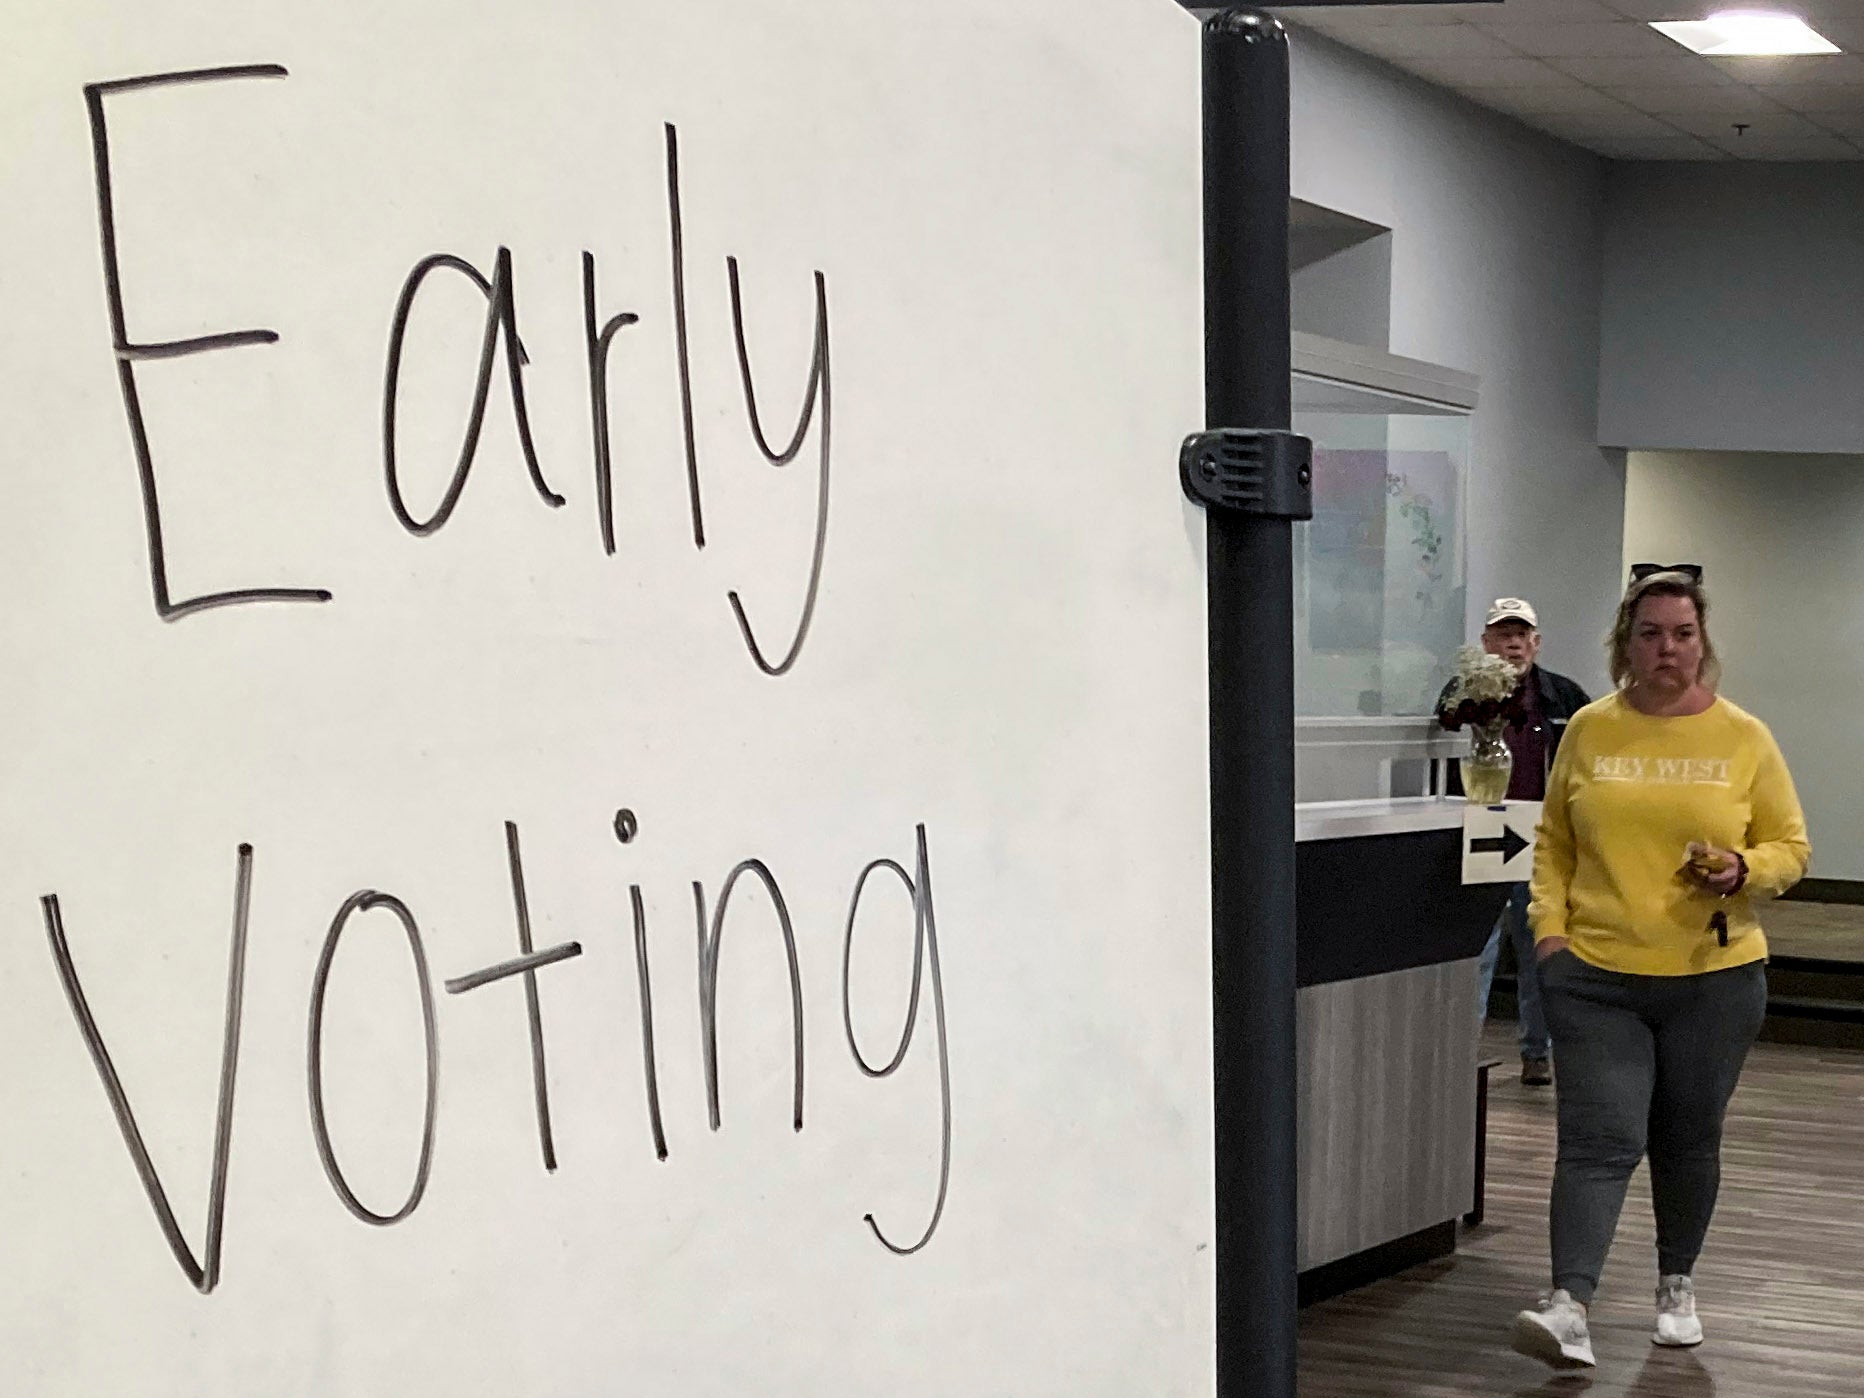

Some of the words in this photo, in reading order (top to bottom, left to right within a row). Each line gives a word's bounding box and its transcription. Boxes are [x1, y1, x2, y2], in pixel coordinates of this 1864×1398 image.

[83, 63, 831, 676] Early
[1593, 755, 1648, 776] KEY
[1656, 757, 1731, 779] WEST
[40, 808, 951, 1294] Voting
